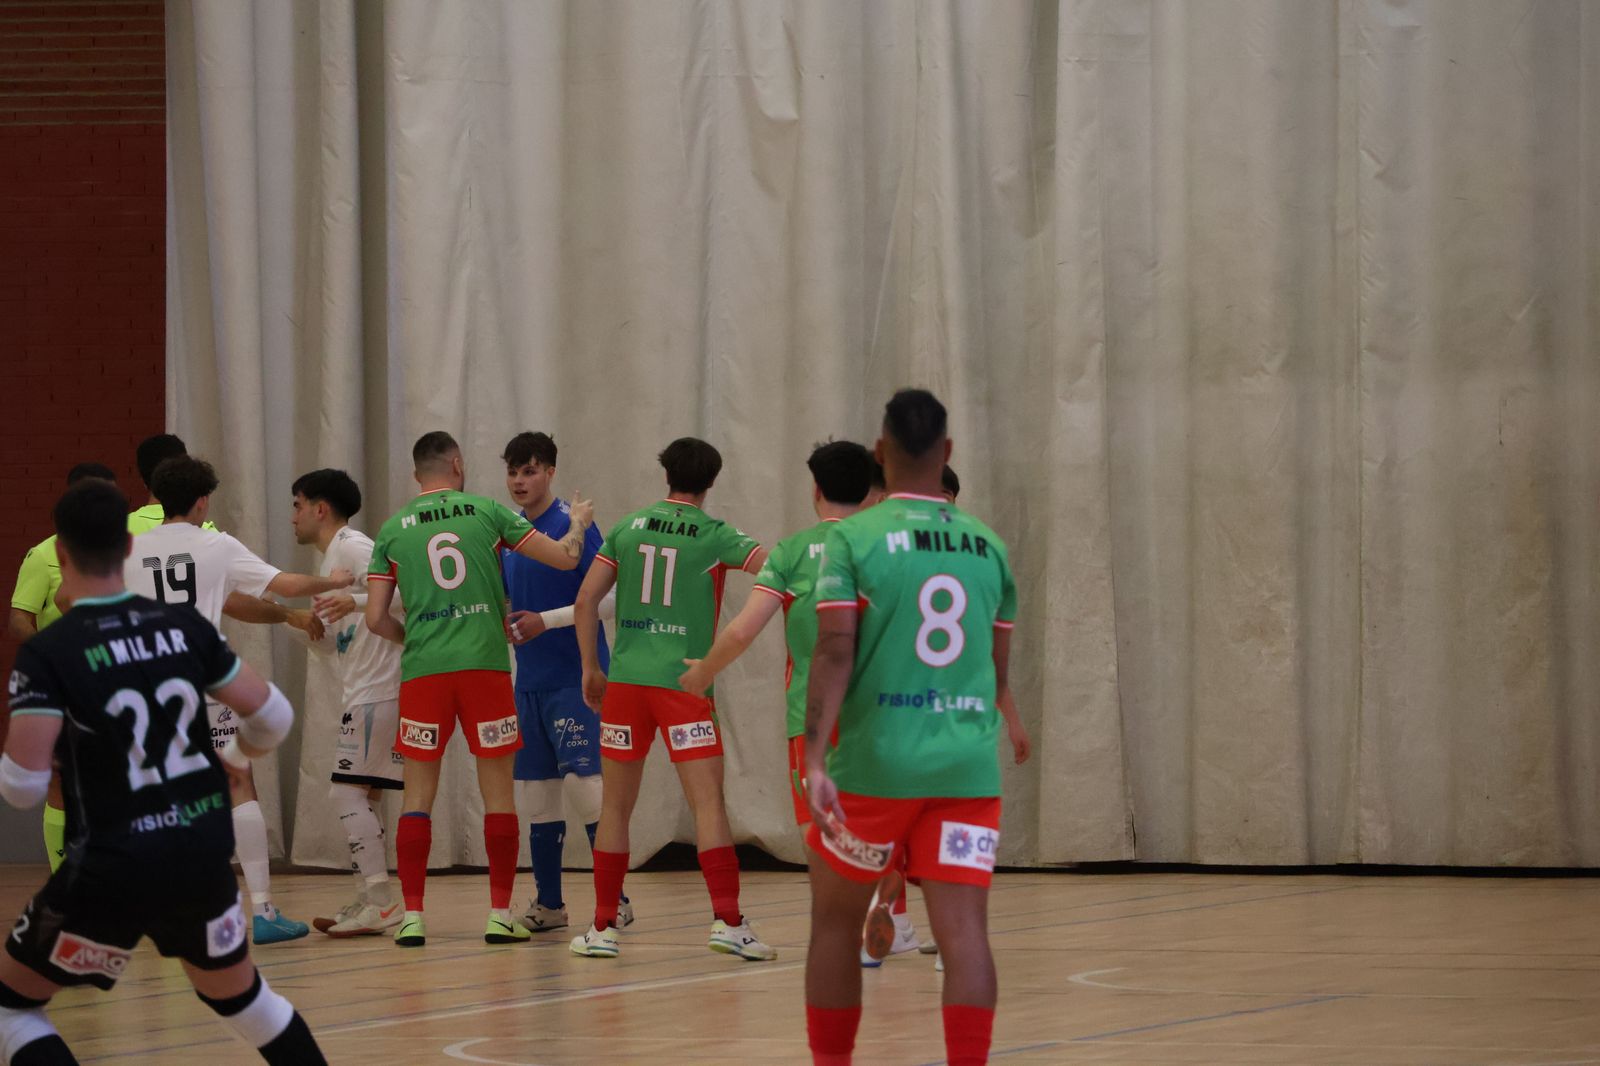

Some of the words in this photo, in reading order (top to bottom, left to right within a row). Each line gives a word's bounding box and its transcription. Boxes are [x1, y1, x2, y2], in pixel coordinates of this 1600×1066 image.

[419, 504, 476, 524] MILAR
[647, 517, 700, 538] MILAR
[914, 529, 989, 559] MILAR
[427, 532, 467, 590] 6
[638, 543, 678, 608] 11
[142, 552, 197, 609] 19
[659, 623, 687, 636] LIFE
[915, 573, 968, 668] 8
[108, 628, 189, 665] MILAR
[105, 677, 212, 792] 22
[501, 719, 517, 735] chc
[690, 723, 713, 738] chc
